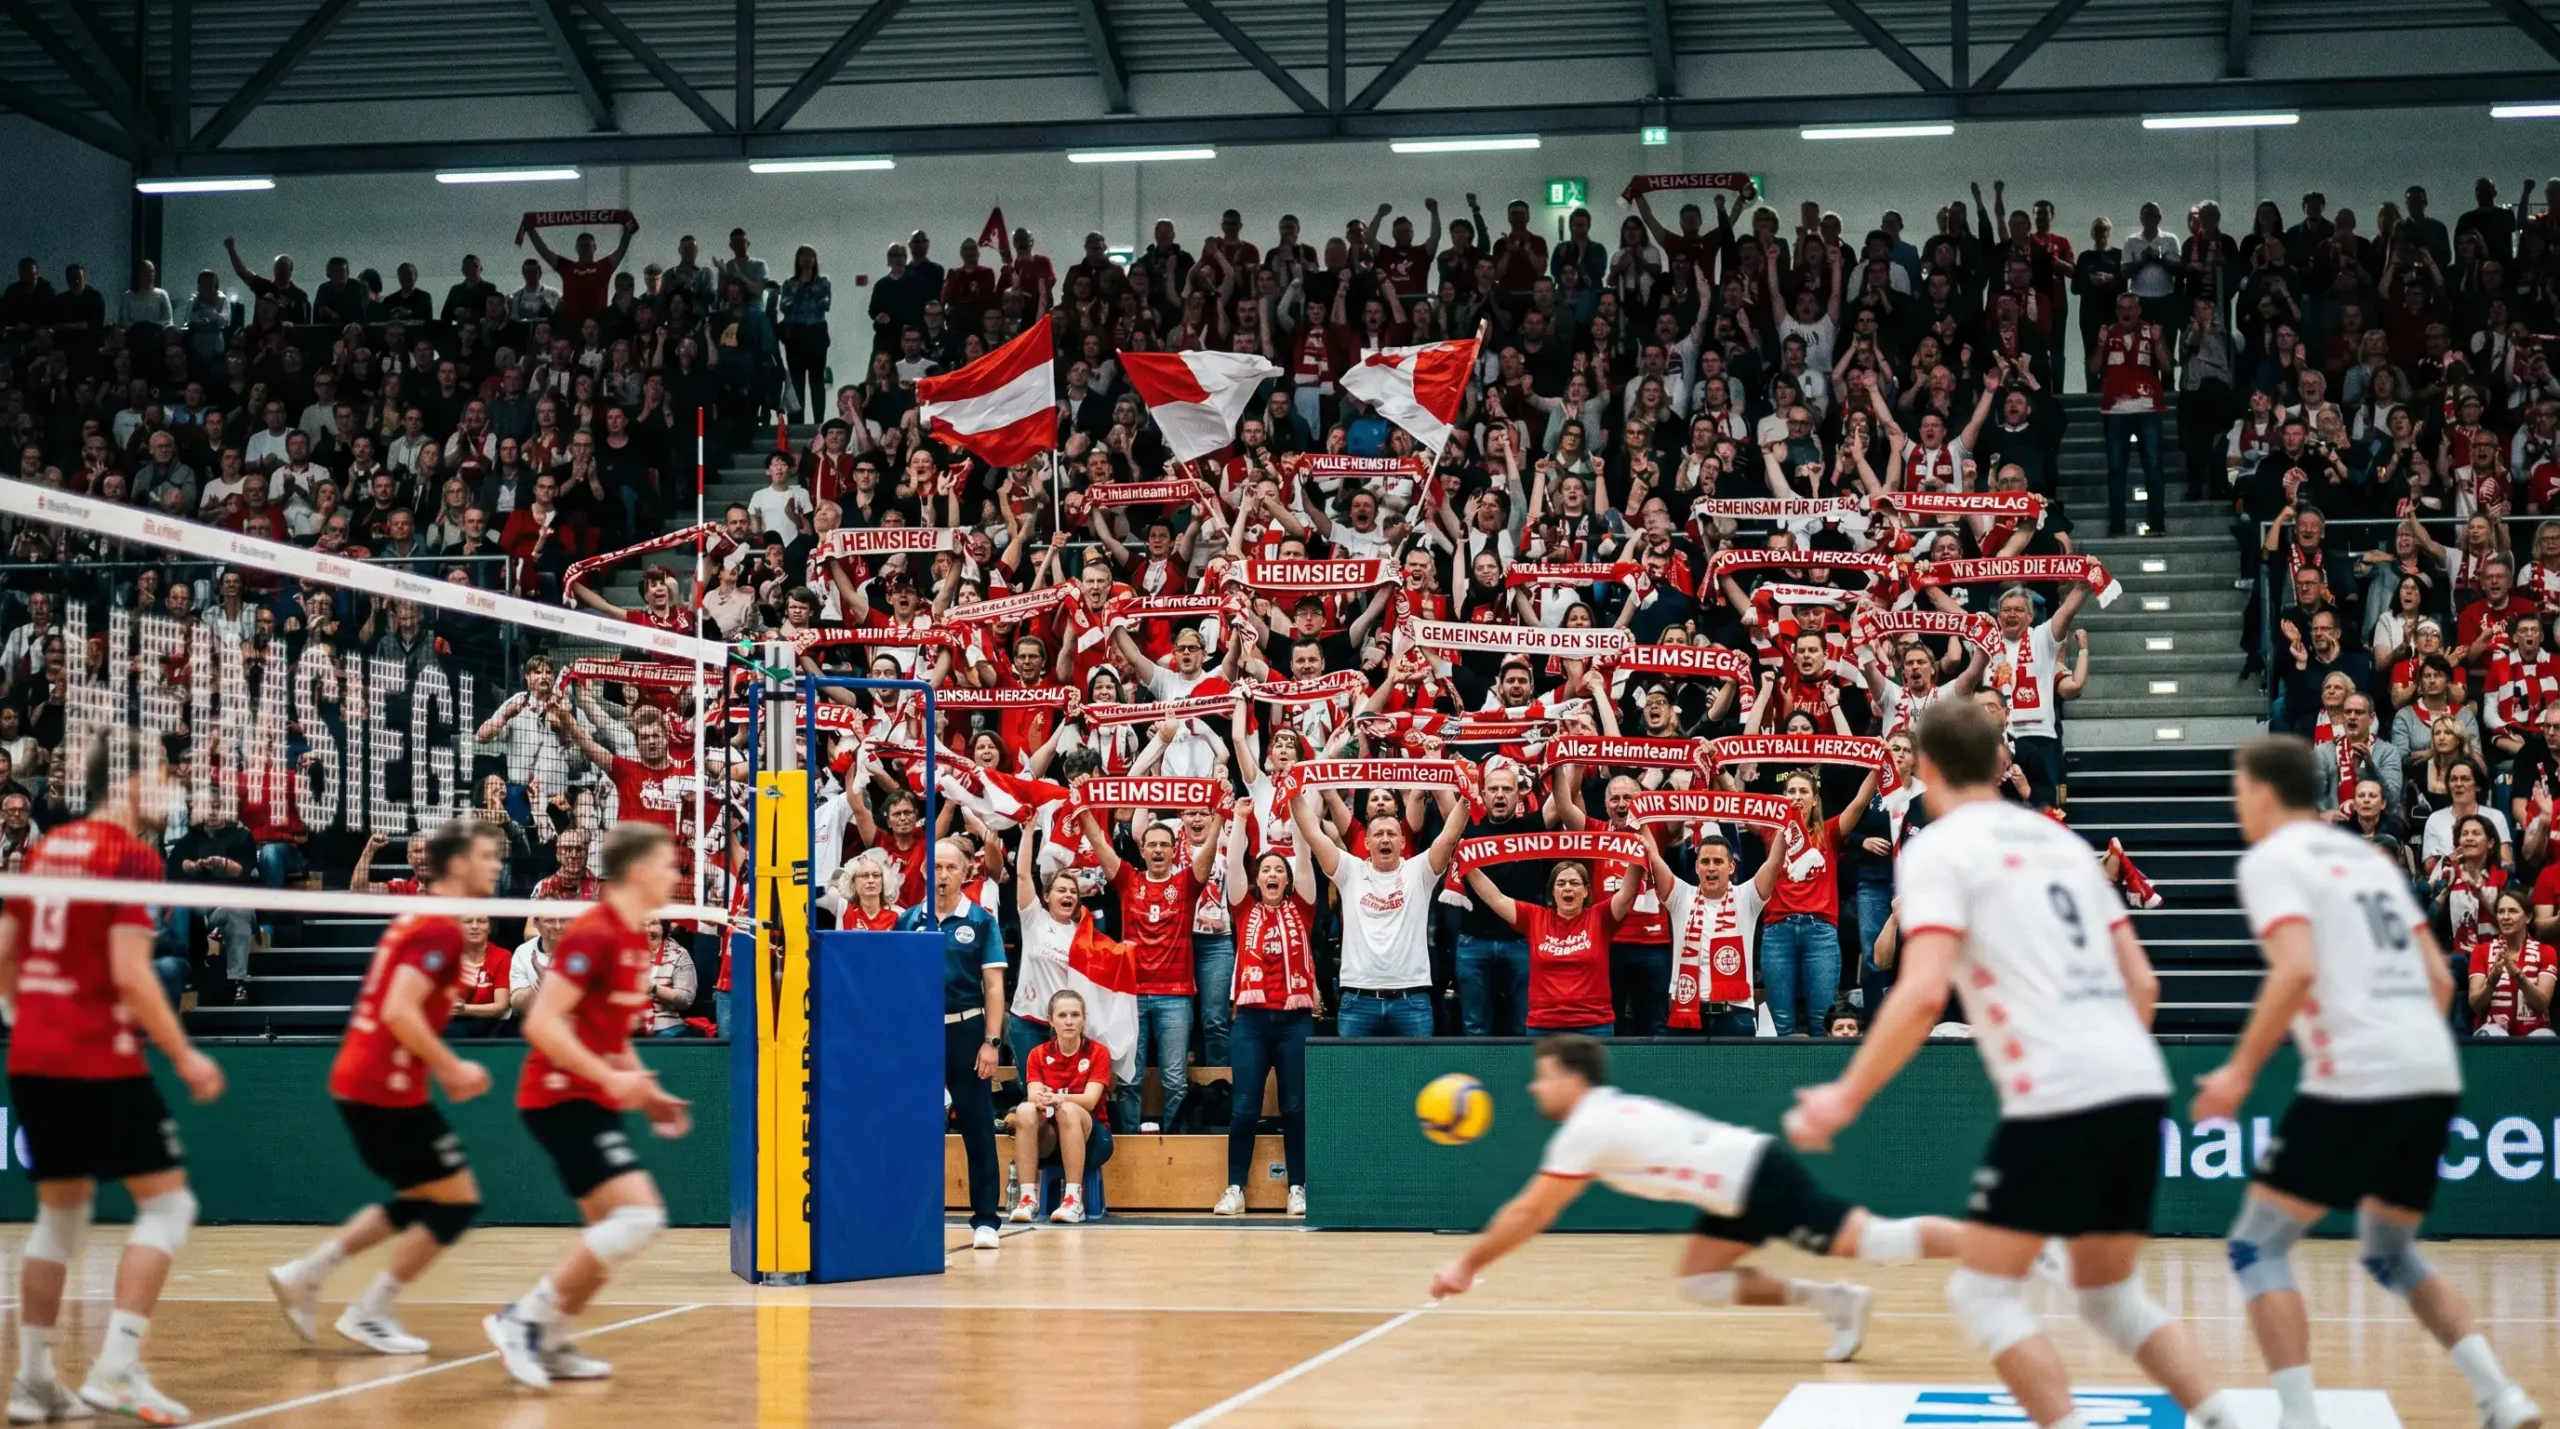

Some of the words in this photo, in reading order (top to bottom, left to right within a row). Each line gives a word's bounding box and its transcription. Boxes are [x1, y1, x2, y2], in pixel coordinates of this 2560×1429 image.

[1648, 175, 1733, 188] HEIMSIEG!
[535, 210, 615, 224] HEIMSIEG!
[1706, 500, 1781, 515] GEMEINSAM
[842, 529, 938, 552] HEIMSIEG!
[1717, 550, 1809, 568] VOLLEYBALL
[1978, 560, 2020, 576] SINDS
[2023, 558, 2047, 574] DIE
[2050, 556, 2083, 573] FANS
[1256, 563, 1366, 583] HEIMSIEG!
[1422, 626, 1512, 645] GEMEINSAM
[1517, 630, 1545, 647] FÜR
[1551, 634, 1580, 648] DEN
[1585, 635, 1625, 649] SIEG!
[1621, 647, 1738, 671] HEIMSIEG!
[934, 688, 993, 702] EINSBALL
[1556, 741, 1596, 758] Allez
[1601, 742, 1689, 760] Heimteam!
[1719, 738, 1810, 756] VOLLEYBALL
[1302, 762, 1364, 784] ALLEZ
[1368, 763, 1454, 783] Heimteam
[1088, 782, 1212, 803] HEIMSIEG!
[1632, 794, 1665, 814] WIR
[1668, 793, 1710, 812] SIND
[1713, 797, 1740, 815] DIE
[1743, 800, 1788, 821] FANS
[1458, 841, 1498, 863] WIR
[1504, 835, 1553, 854] SIND
[1558, 835, 1593, 851] DIE
[1597, 835, 1646, 858] FANS
[2047, 881, 2087, 948] 9
[2354, 889, 2409, 950] 16
